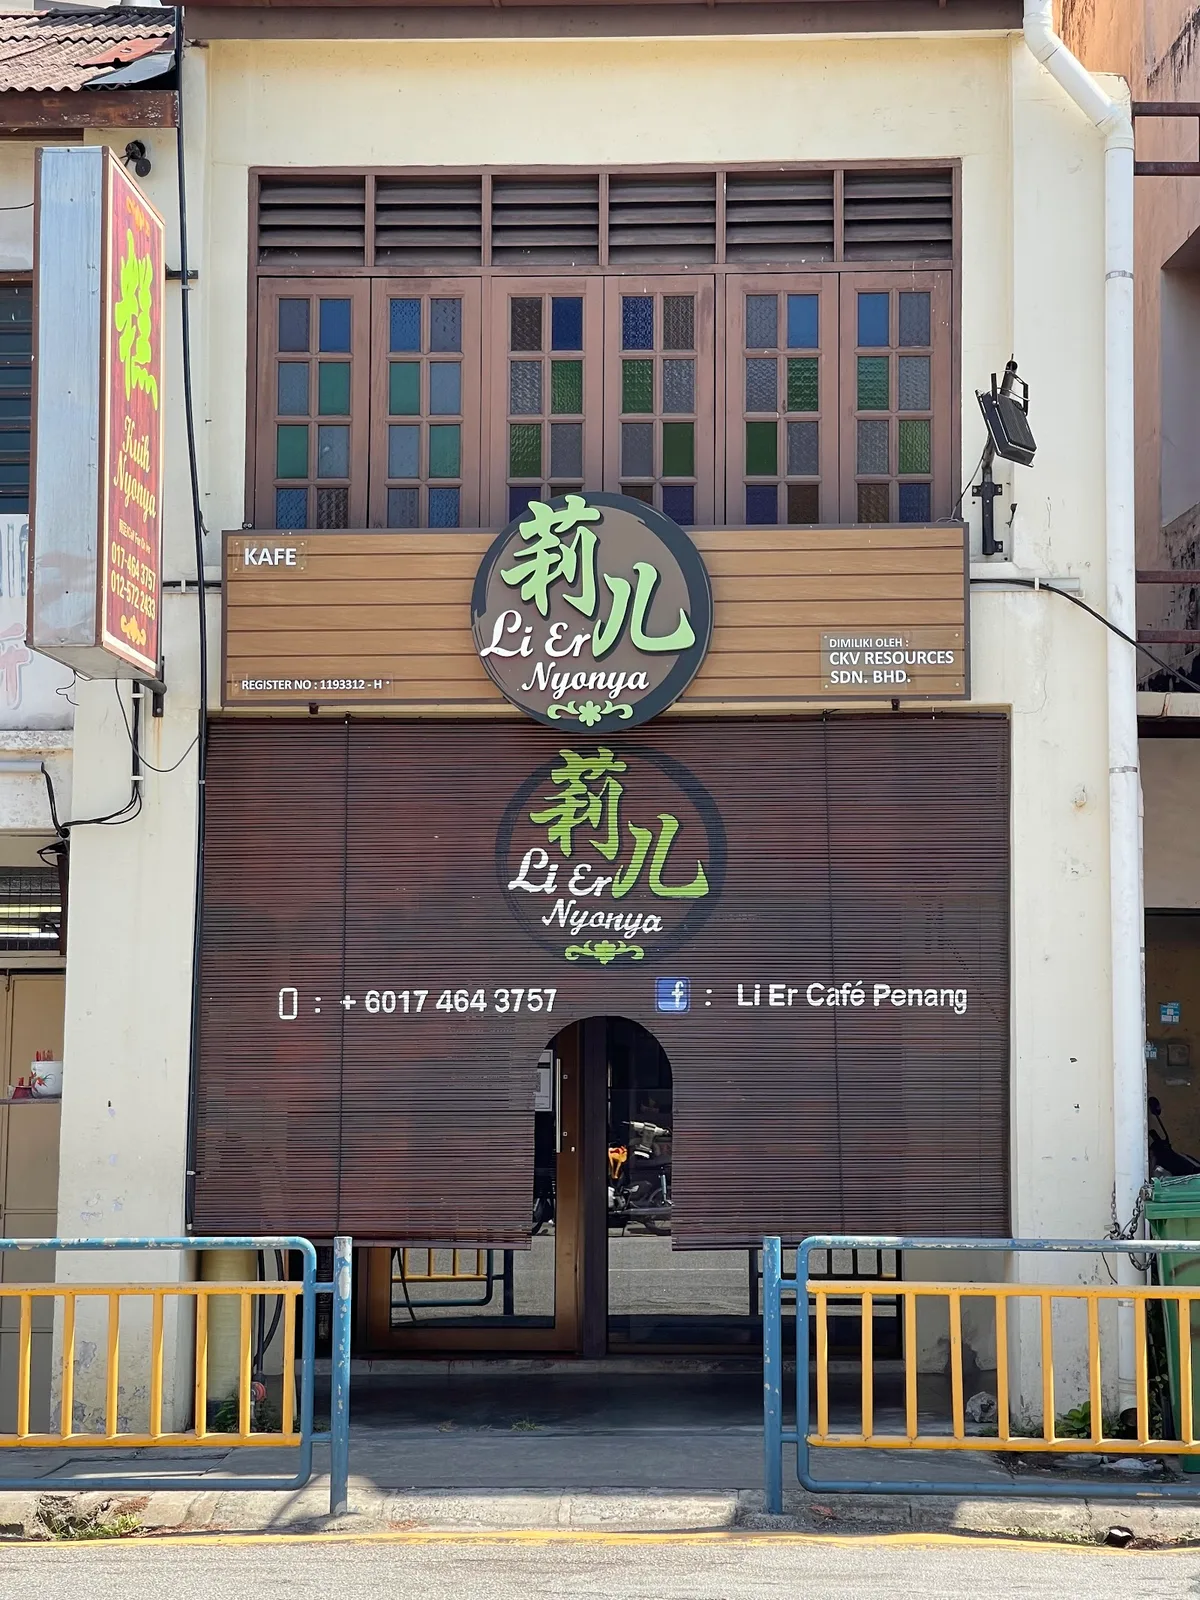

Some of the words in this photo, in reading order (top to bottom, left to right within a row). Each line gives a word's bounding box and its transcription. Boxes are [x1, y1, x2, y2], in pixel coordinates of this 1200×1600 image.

[122, 415, 150, 473] Kuih
[113, 450, 156, 523] Nyonya
[244, 548, 297, 566] KAFE
[140, 562, 156, 593] 3757
[480, 609, 533, 657] Li
[544, 622, 591, 657] Er
[829, 638, 873, 648] DIMILIKI
[875, 638, 903, 648] OLEH
[829, 651, 861, 665] CKV
[864, 650, 954, 665] RESOURCES
[241, 679, 292, 690] REGISTER
[294, 679, 312, 690] NO
[320, 679, 365, 690] 1193312
[521, 661, 650, 700] Nyonya
[830, 670, 868, 684] SDN.
[873, 670, 911, 683] BHD.
[507, 848, 559, 894] Li
[568, 864, 613, 897] Er
[541, 898, 664, 939] Nyonya
[365, 990, 429, 1014] 6017
[436, 989, 488, 1013] 464
[494, 988, 558, 1013] 3757
[737, 984, 760, 1006] Li
[768, 984, 798, 1006] Er
[806, 980, 865, 1007] Café
[873, 984, 967, 1015] Penang
